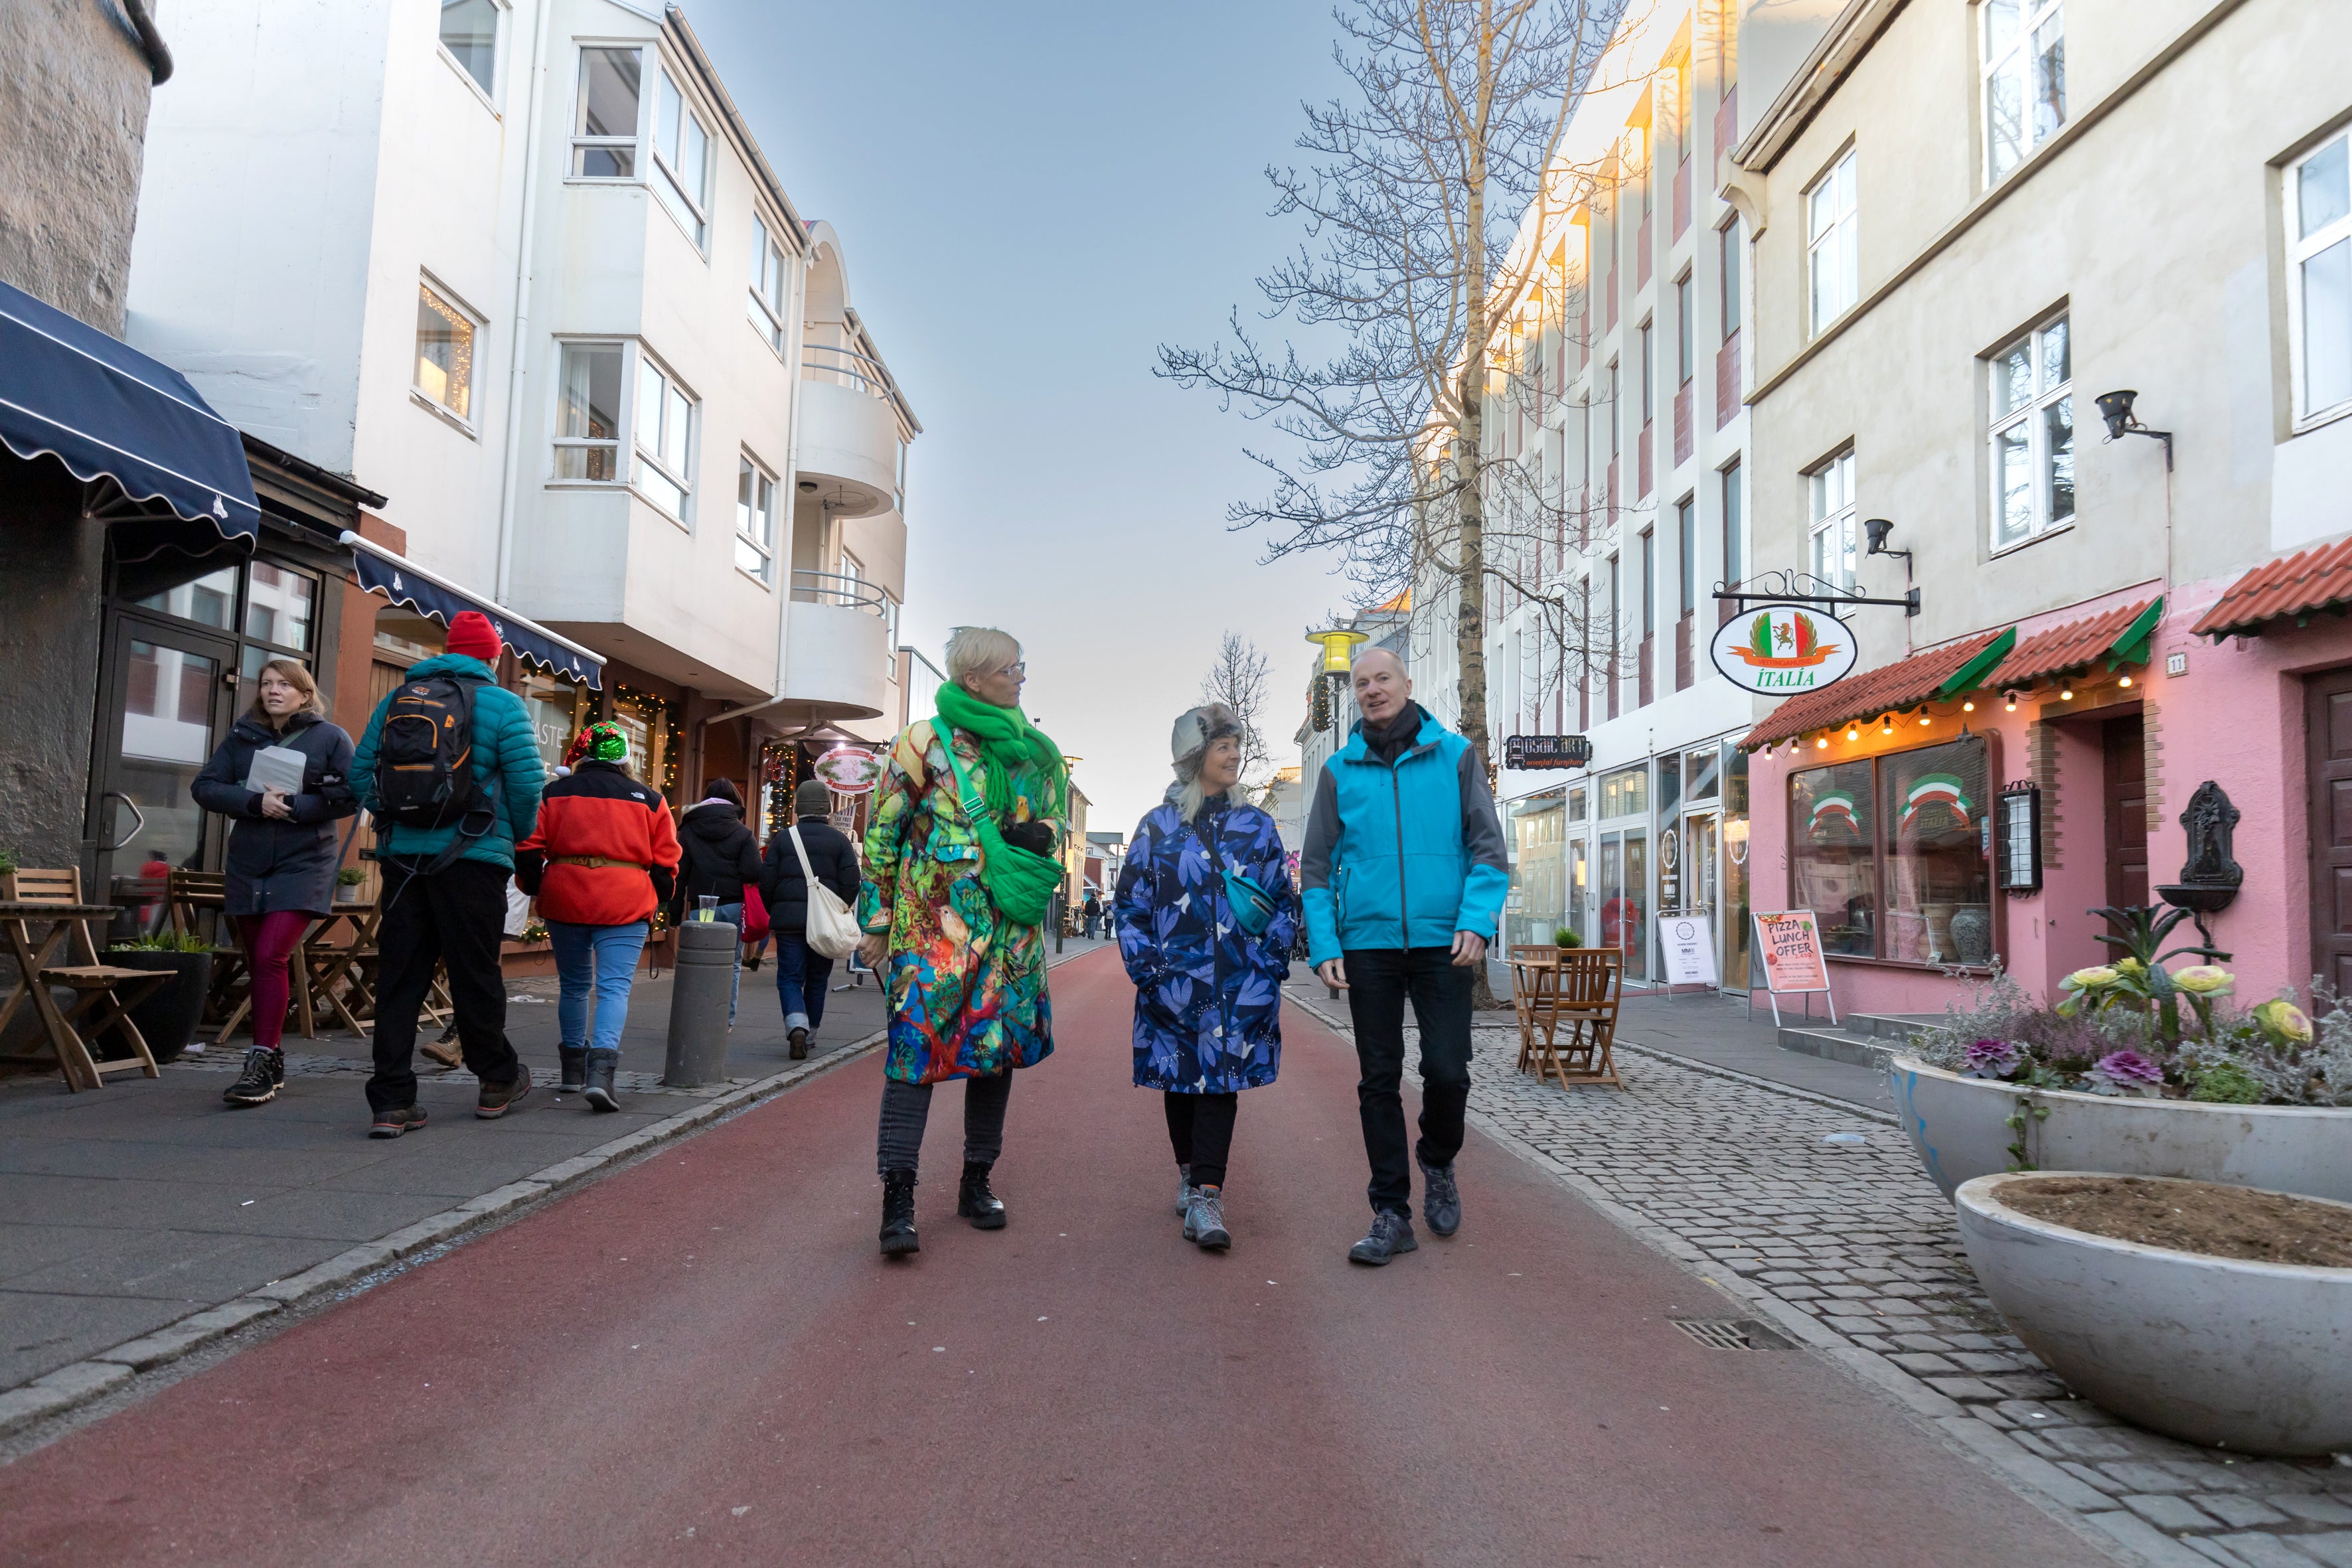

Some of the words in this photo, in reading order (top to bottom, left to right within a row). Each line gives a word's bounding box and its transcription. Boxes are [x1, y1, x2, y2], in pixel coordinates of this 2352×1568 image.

[2171, 659, 2182, 671] 11
[1756, 667, 1814, 687] ÍTALÍA
[531, 719, 564, 749] ASTE
[1526, 758, 1553, 767] oriental
[1553, 758, 1584, 767] furniture
[1768, 919, 1800, 934] PIZZA
[1771, 930, 1810, 945] LUNCH
[1776, 943, 1814, 957] OFFER
